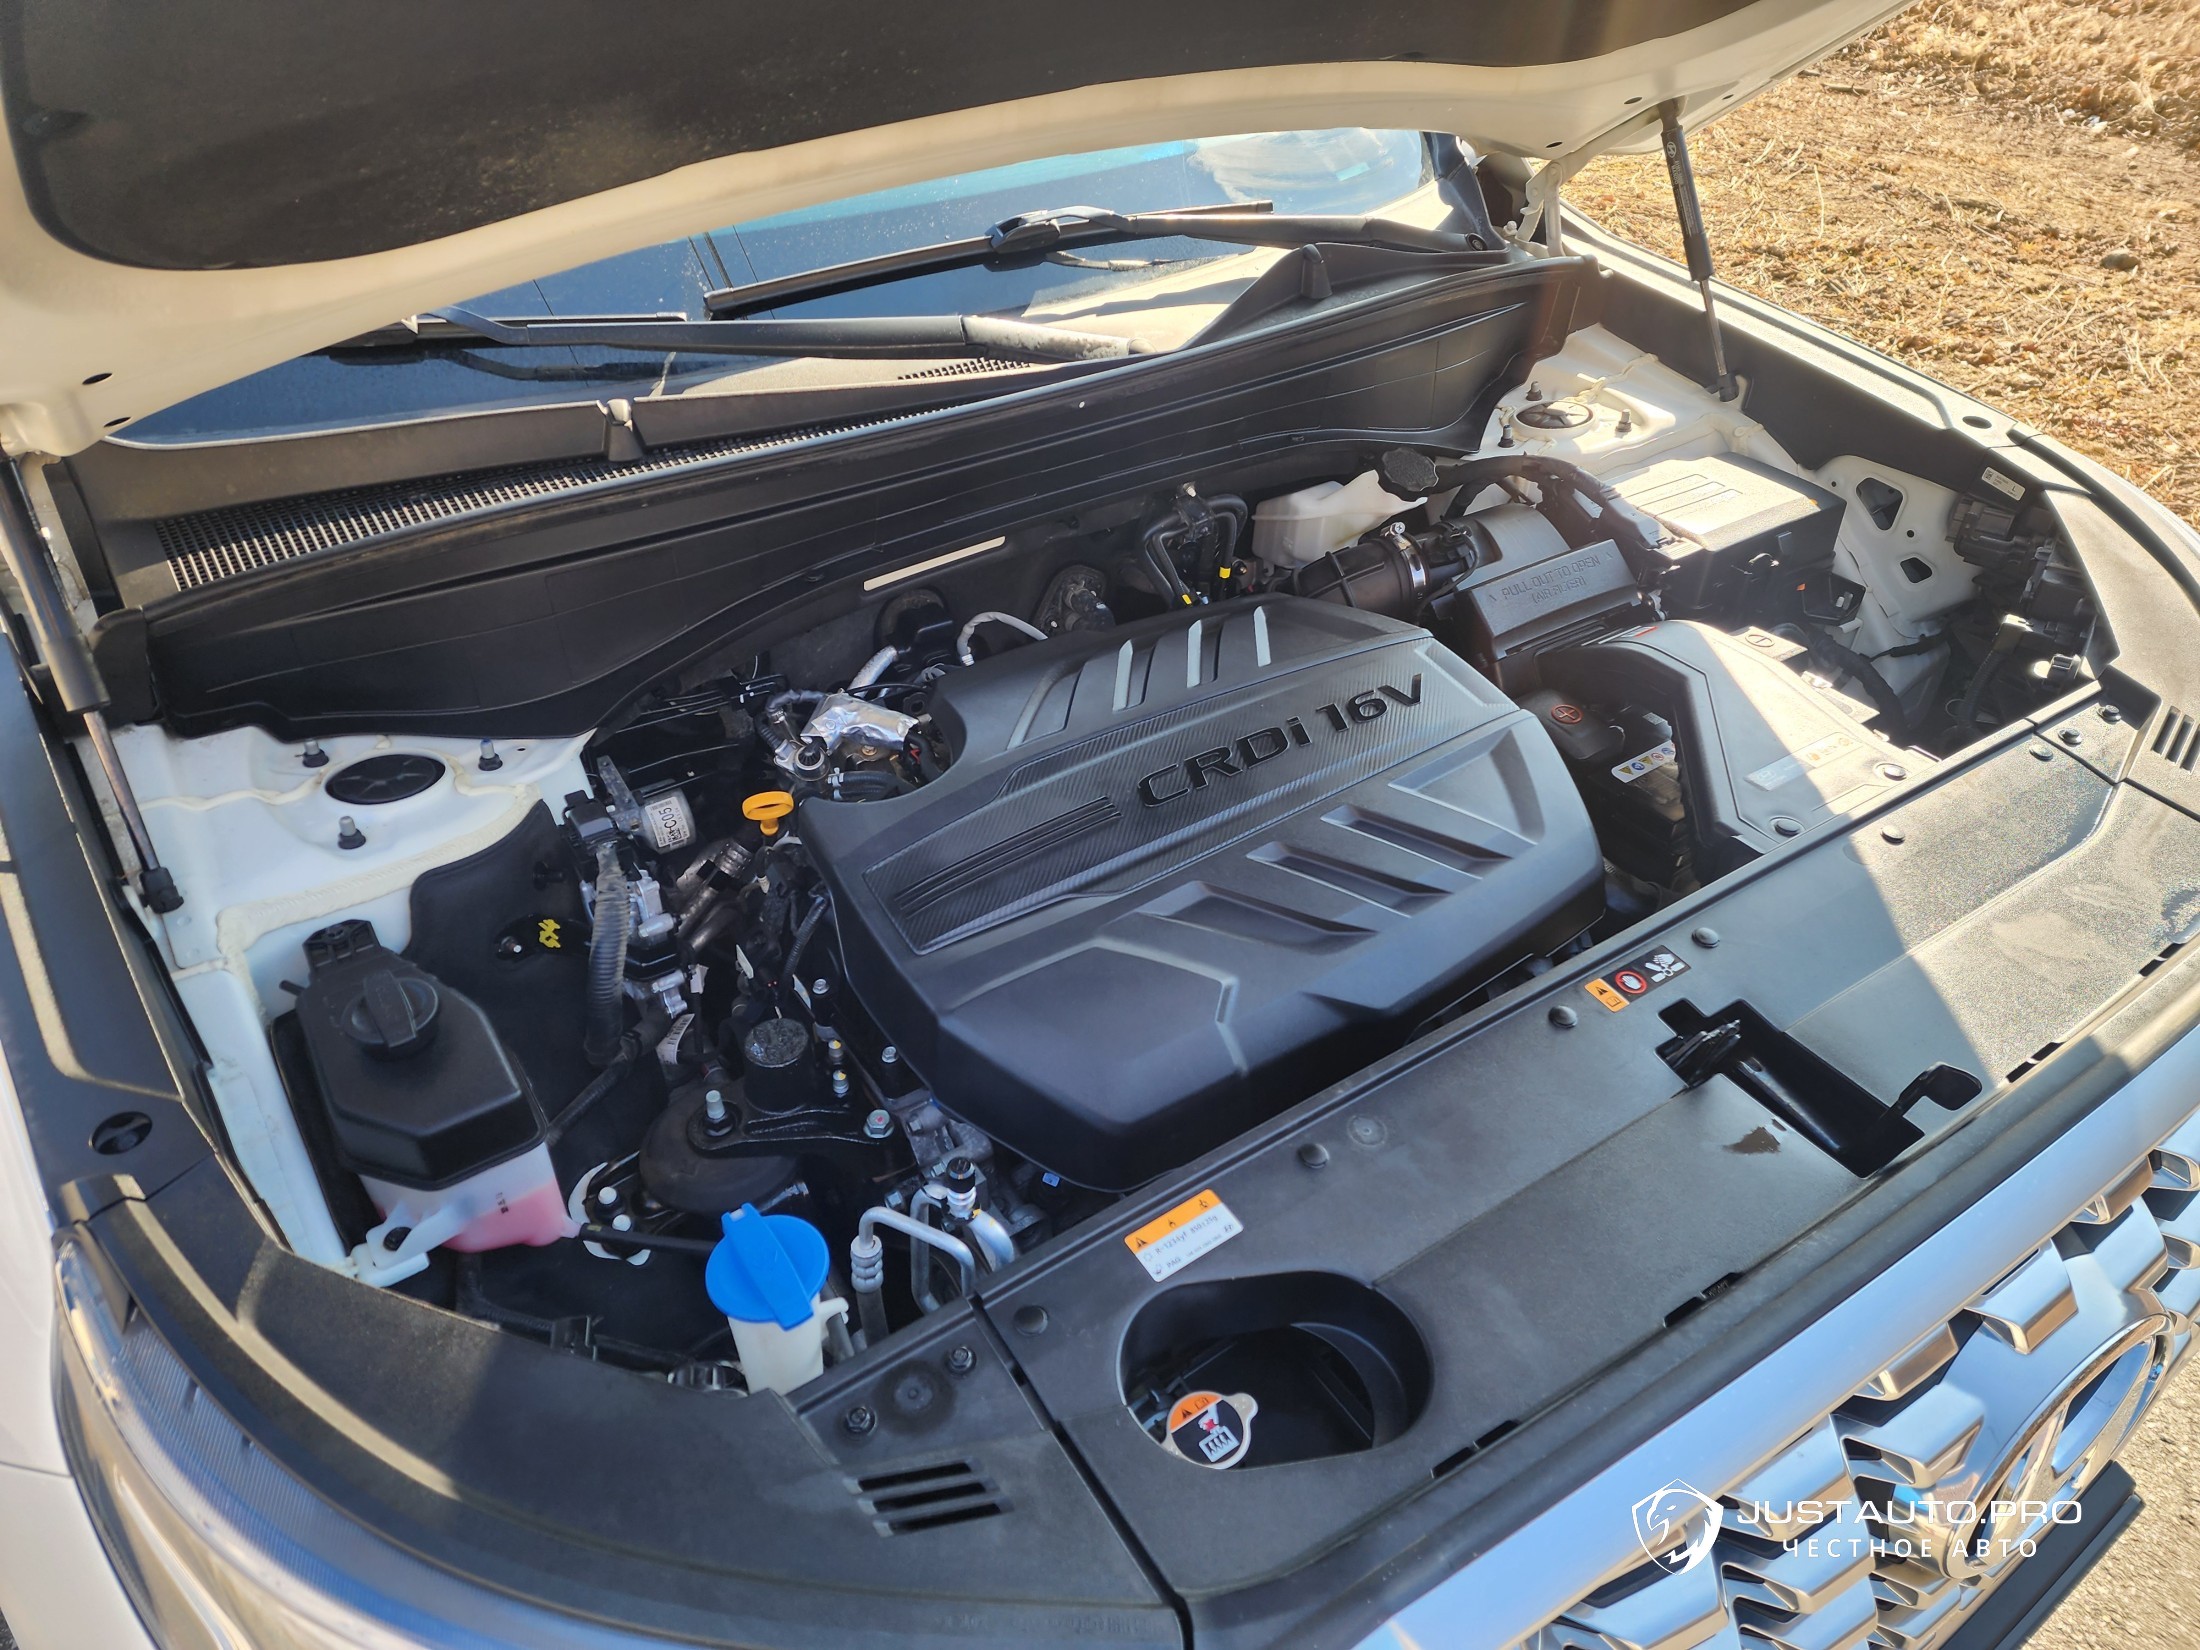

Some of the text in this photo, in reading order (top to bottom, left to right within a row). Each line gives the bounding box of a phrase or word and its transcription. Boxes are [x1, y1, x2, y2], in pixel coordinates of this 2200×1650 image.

[1501, 555, 1600, 600] PULL OUT TO OPEN
[1137, 673, 1422, 807] CRDi 16V
